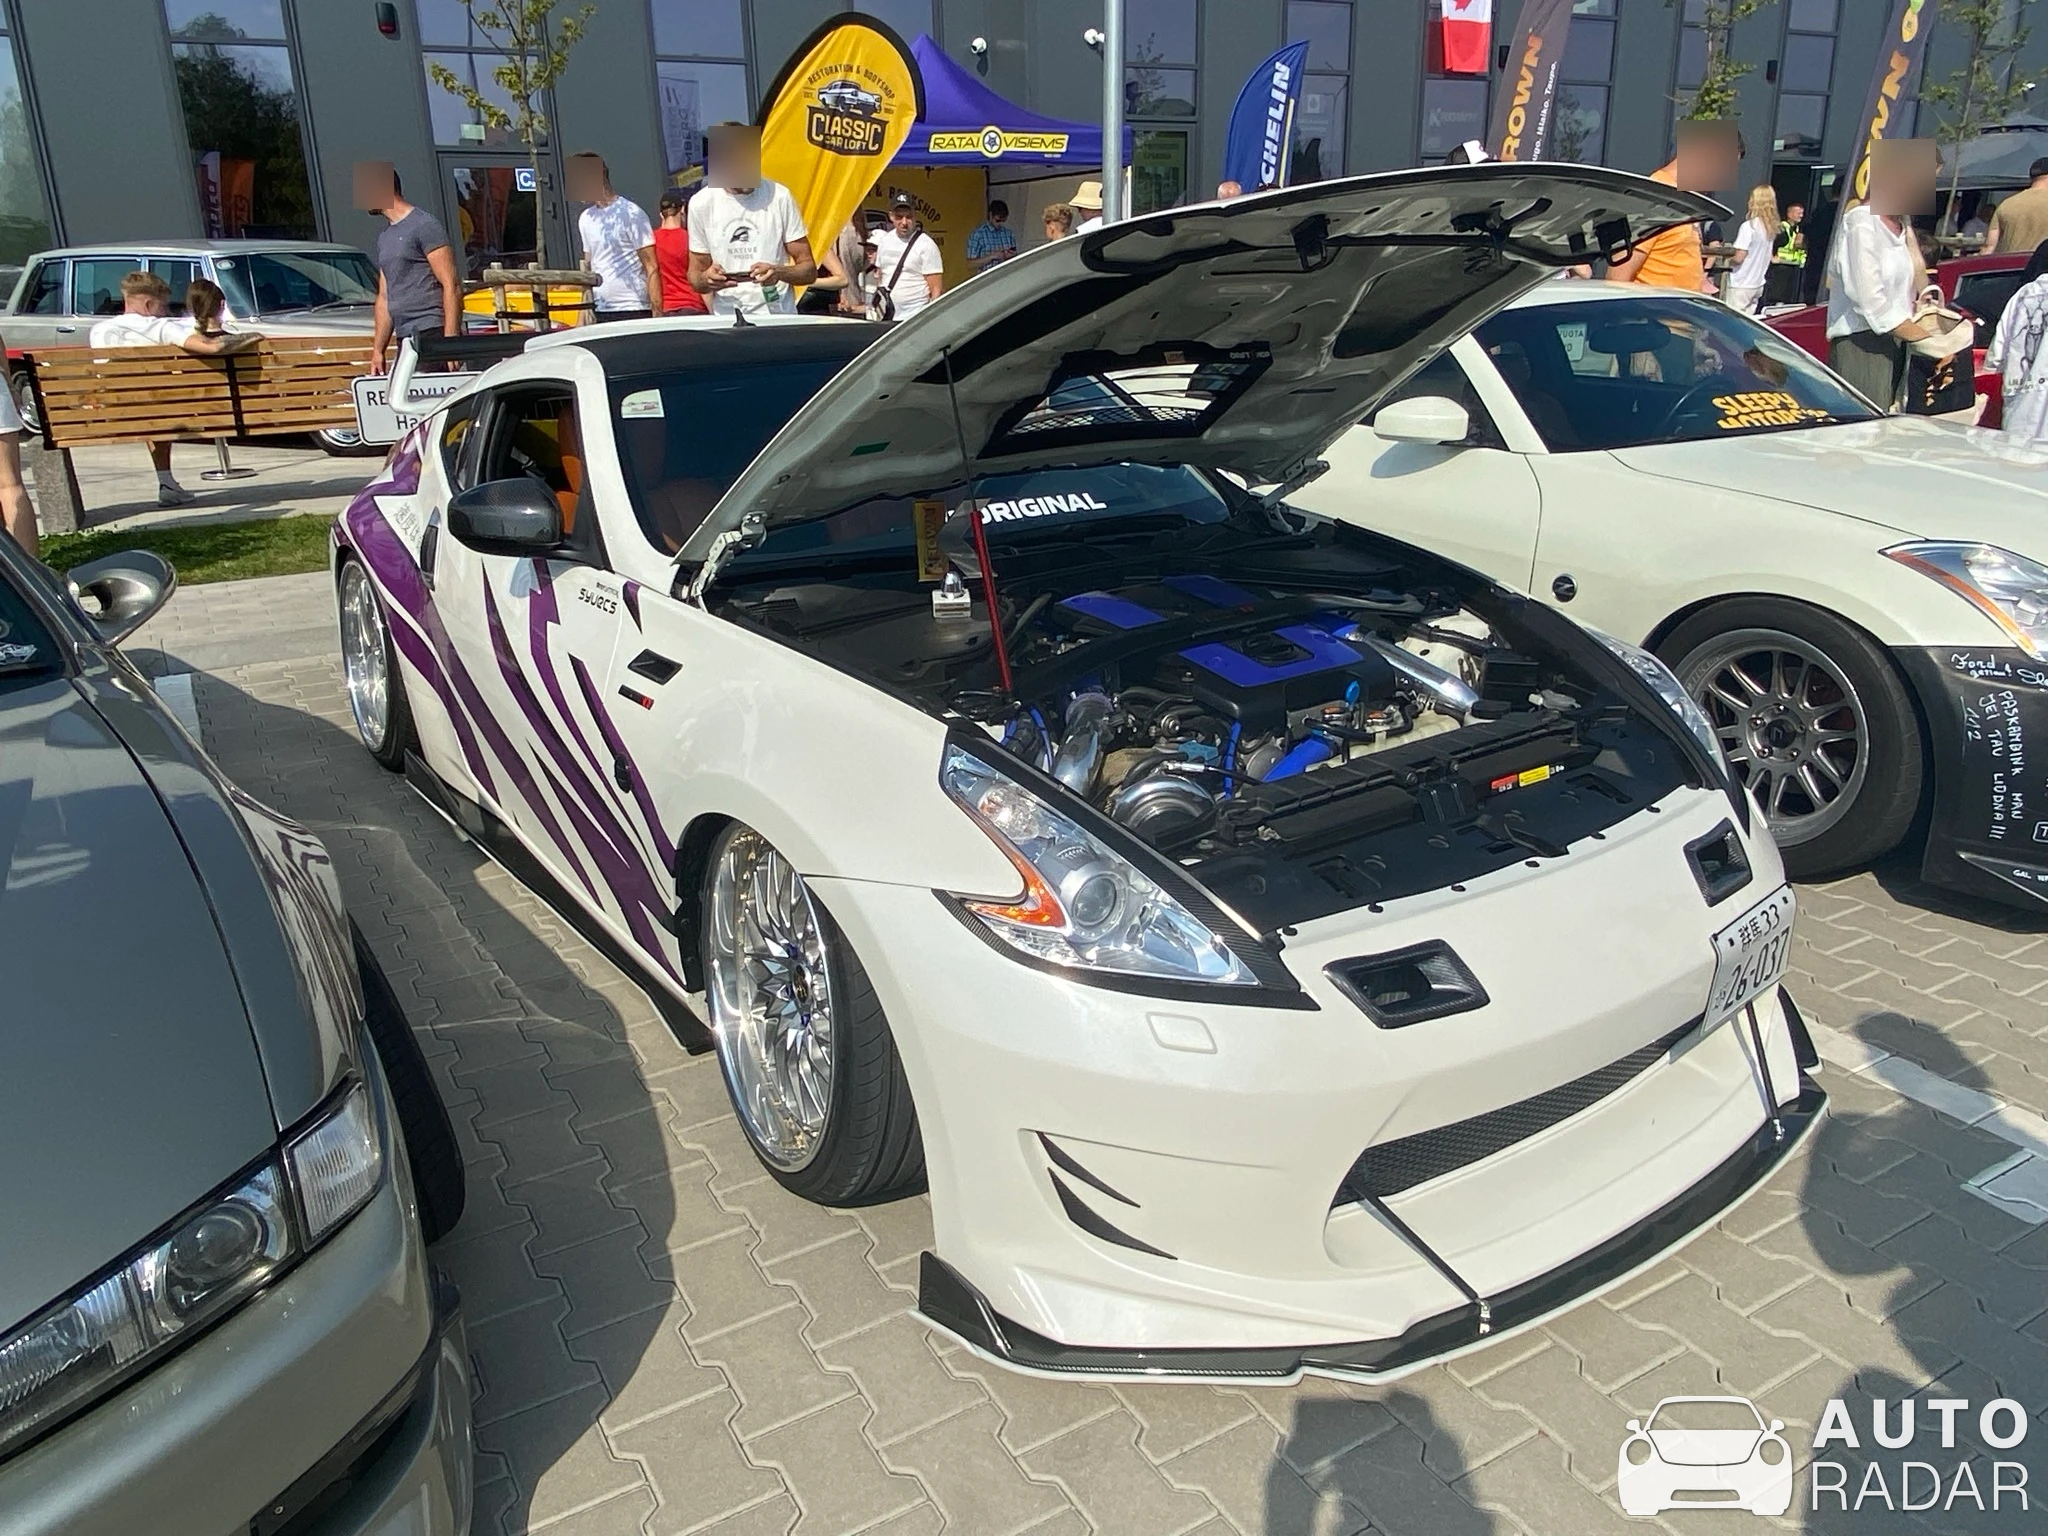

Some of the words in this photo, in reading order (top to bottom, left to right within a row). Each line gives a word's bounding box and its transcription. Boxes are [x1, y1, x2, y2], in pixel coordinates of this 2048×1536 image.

[807, 64, 854, 86] RESTORATION
[855, 65, 861, 75] &
[863, 69, 896, 100] BODYSHOP
[1501, 34, 1543, 161] ROWN
[680, 107, 693, 165] MBERG
[811, 113, 882, 152] CLASSIC
[1258, 61, 1290, 187] CHELIN
[824, 135, 842, 149] CAR
[843, 137, 867, 151] LOFT
[932, 136, 980, 149] RATAI
[1003, 136, 1066, 149] VISIEMS
[728, 246, 758, 255] NATIVE
[1560, 330, 1584, 339] UOTA
[1712, 392, 1800, 416] SLEEPY
[1998, 690, 2025, 776] PASKAMBINK
[2010, 793, 2024, 820] MAN
[1760, 904, 1780, 936] 33
[1722, 926, 1790, 1012] 26-037
